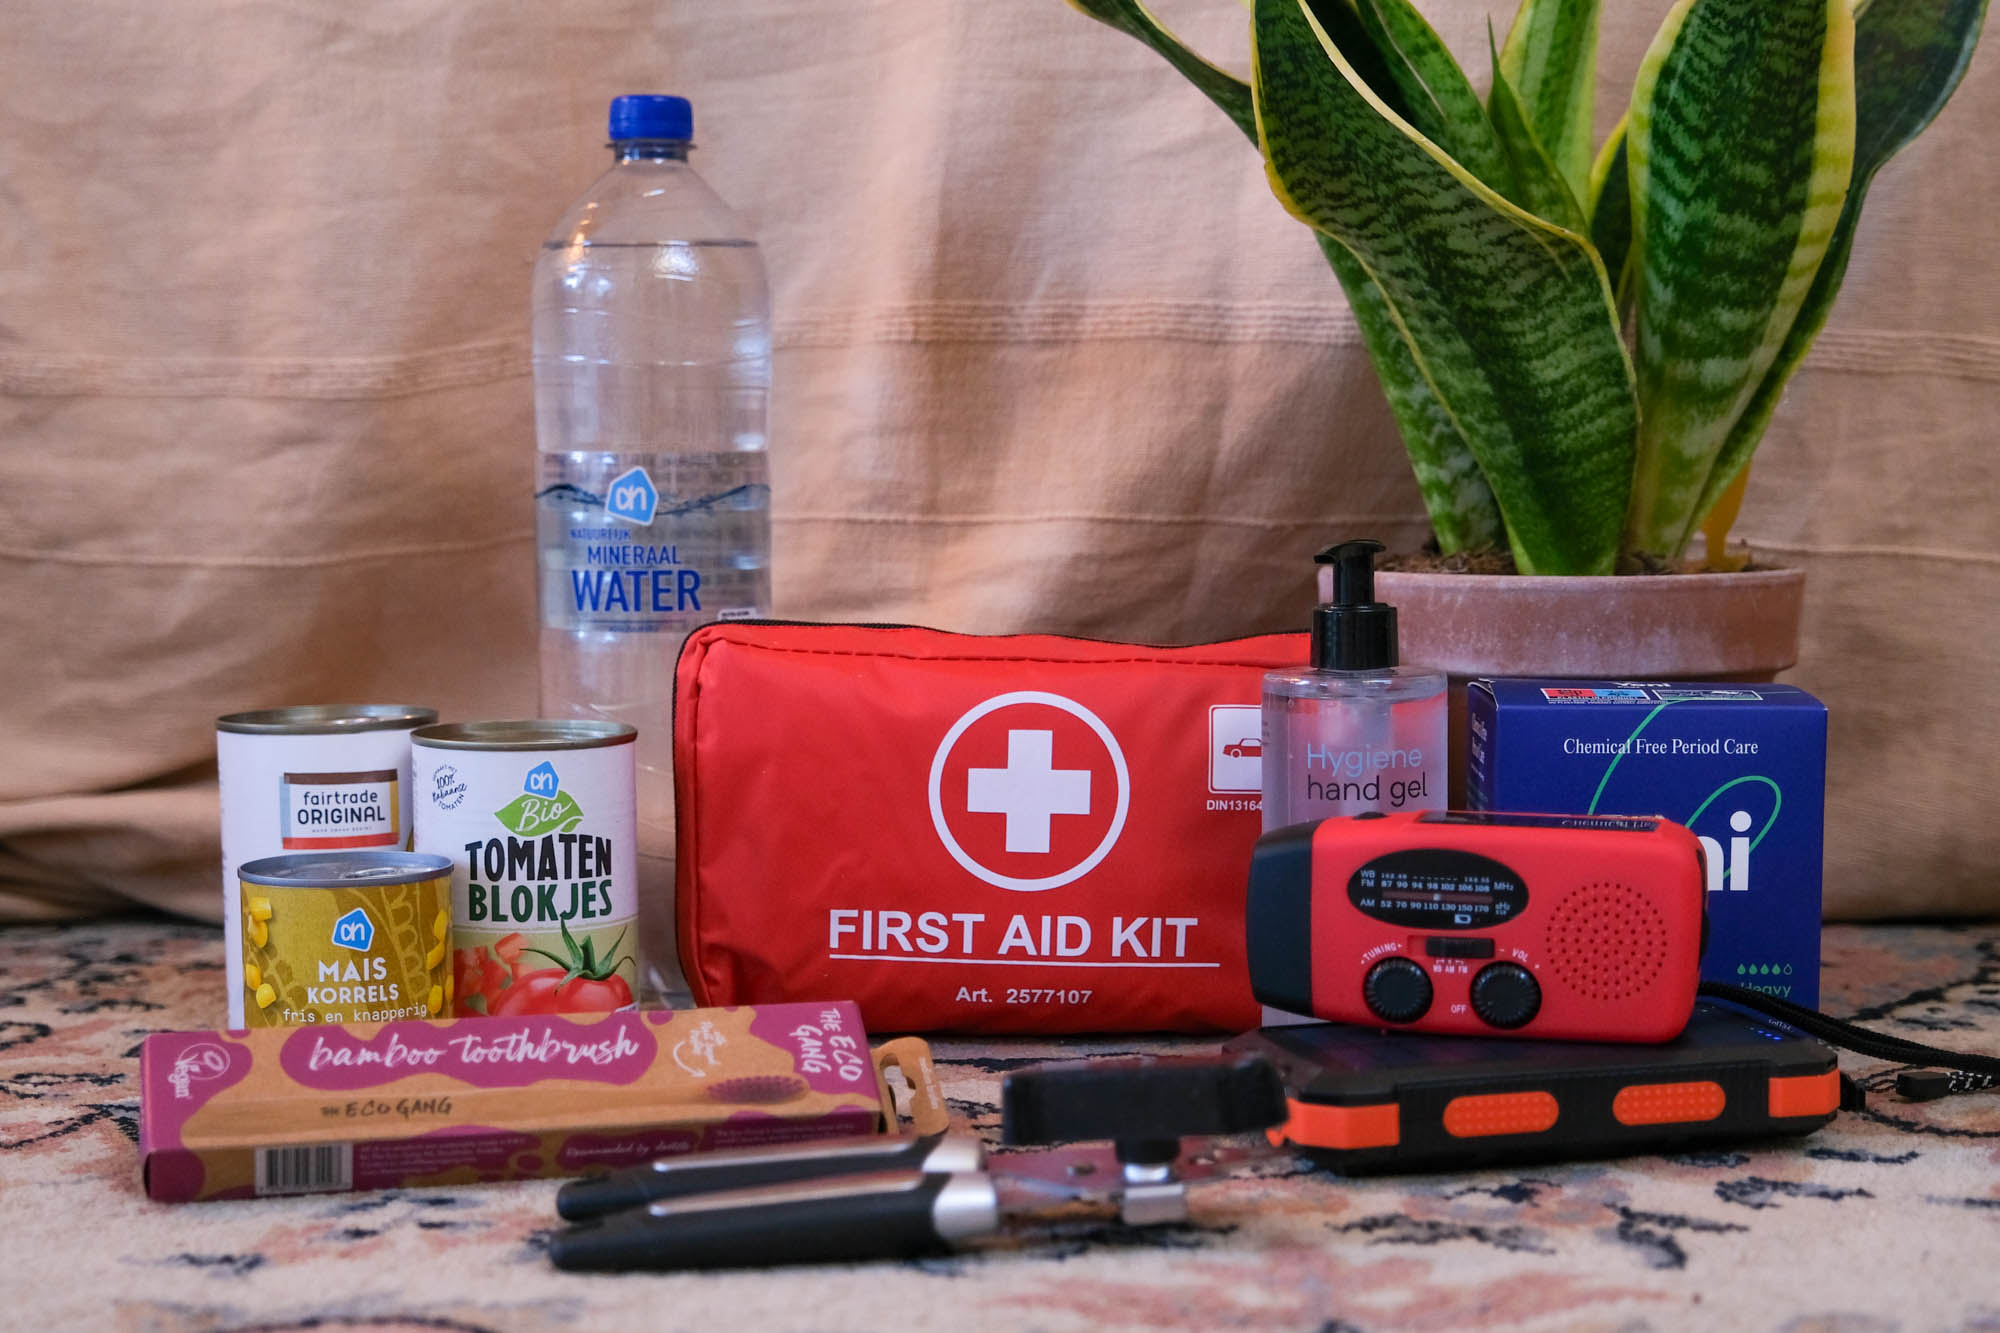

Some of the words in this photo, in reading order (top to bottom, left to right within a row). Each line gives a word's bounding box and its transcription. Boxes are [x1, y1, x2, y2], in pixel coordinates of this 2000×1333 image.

[587, 546, 681, 565] MINERAAL
[571, 570, 702, 612] WATER
[1563, 739, 1631, 755] Chemical
[1636, 739, 1667, 754] Free
[1672, 739, 1719, 755] Period
[1724, 739, 1759, 755] Care
[1307, 743, 1422, 777] Hygiene
[303, 789, 378, 806] fairtrade
[1307, 773, 1380, 801] hand
[1390, 771, 1428, 807] gel
[297, 805, 386, 825] ORIGINAL
[514, 798, 573, 832] Bio
[1207, 800, 1262, 811] DIN13164
[465, 833, 612, 882] TOMATEN
[1360, 879, 1375, 888] FM
[1381, 880, 1393, 889] 87
[1397, 880, 1409, 889] 90
[1440, 883, 1456, 892] 102
[468, 879, 613, 923] BLOKJES
[1360, 898, 1376, 907] AM
[1396, 901, 1408, 909] 70
[1410, 902, 1423, 910] 90
[1424, 902, 1440, 911] 110
[829, 909, 985, 955] FIRST
[998, 914, 1092, 957] AID
[1112, 917, 1199, 958] KIT
[1363, 943, 1397, 961] TUNING
[1512, 948, 1529, 963] VOL
[318, 956, 388, 983] MAIS
[307, 983, 400, 1004] KORRELS
[955, 986, 993, 1003] Art.
[1006, 988, 1093, 1004] 2577107
[283, 1007, 316, 1023] fris
[325, 1012, 344, 1023] en
[353, 1004, 428, 1022] knapperig
[1450, 1004, 1467, 1015] OFF
[308, 1032, 448, 1071] bamboo
[448, 1024, 640, 1065] toothbrush
[788, 1024, 832, 1073] GANG
[829, 1034, 864, 1082] ECO
[345, 1100, 390, 1117] ECO
[396, 1097, 452, 1119] GANG
